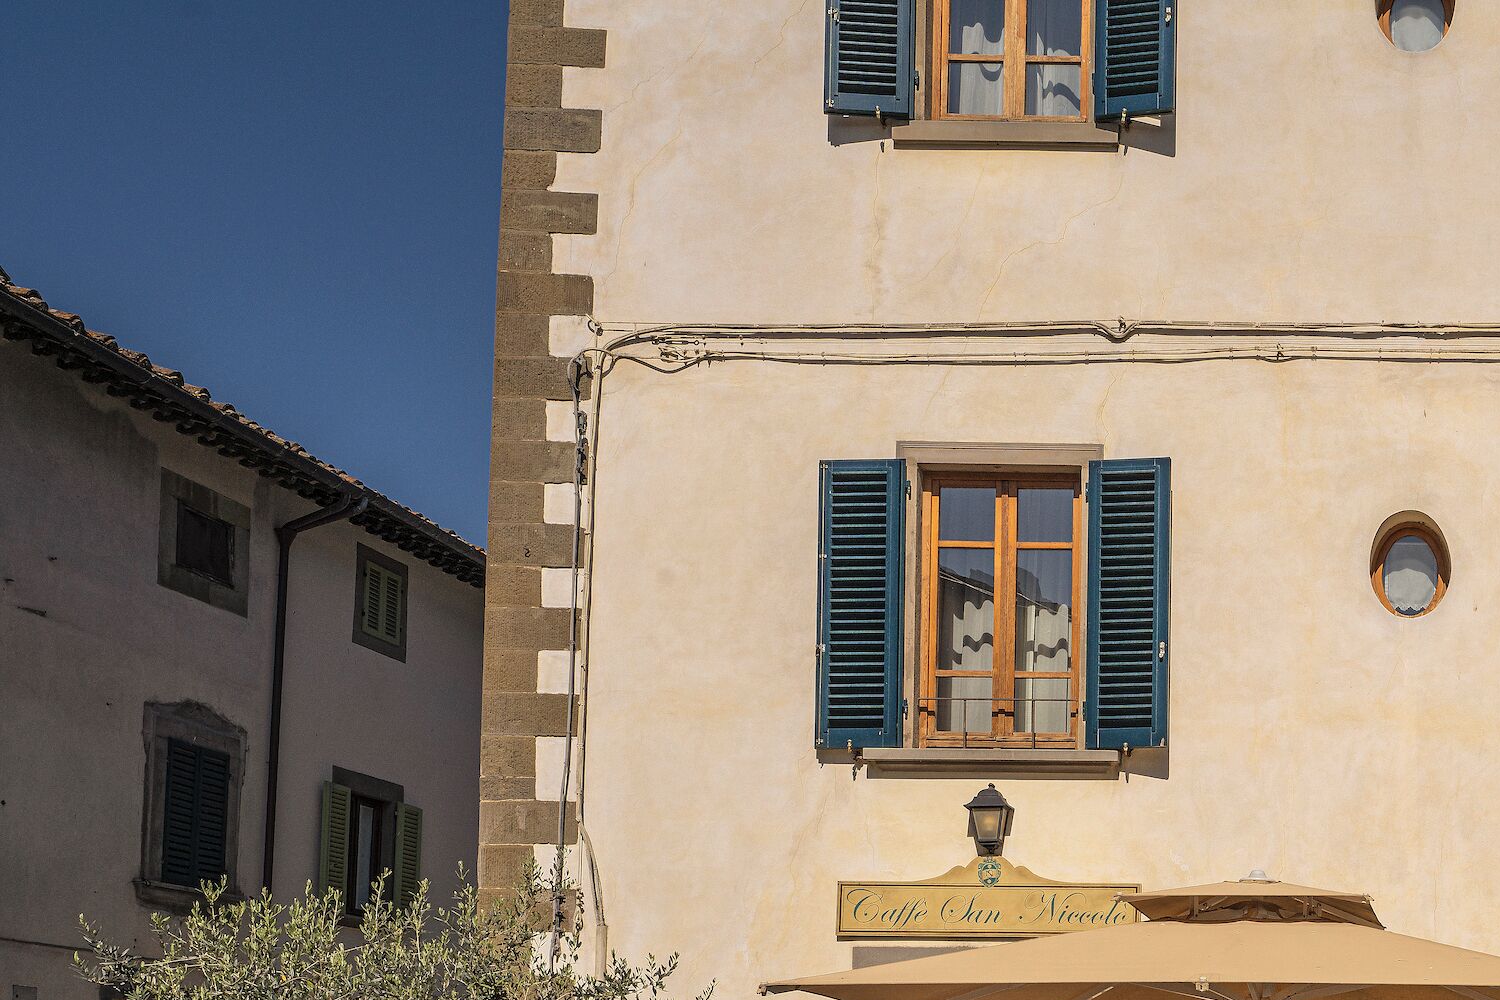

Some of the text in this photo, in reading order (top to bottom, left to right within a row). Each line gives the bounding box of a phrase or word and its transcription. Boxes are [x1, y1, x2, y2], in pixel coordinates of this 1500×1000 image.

[847, 888, 1130, 930] Caffè San Niccolò
